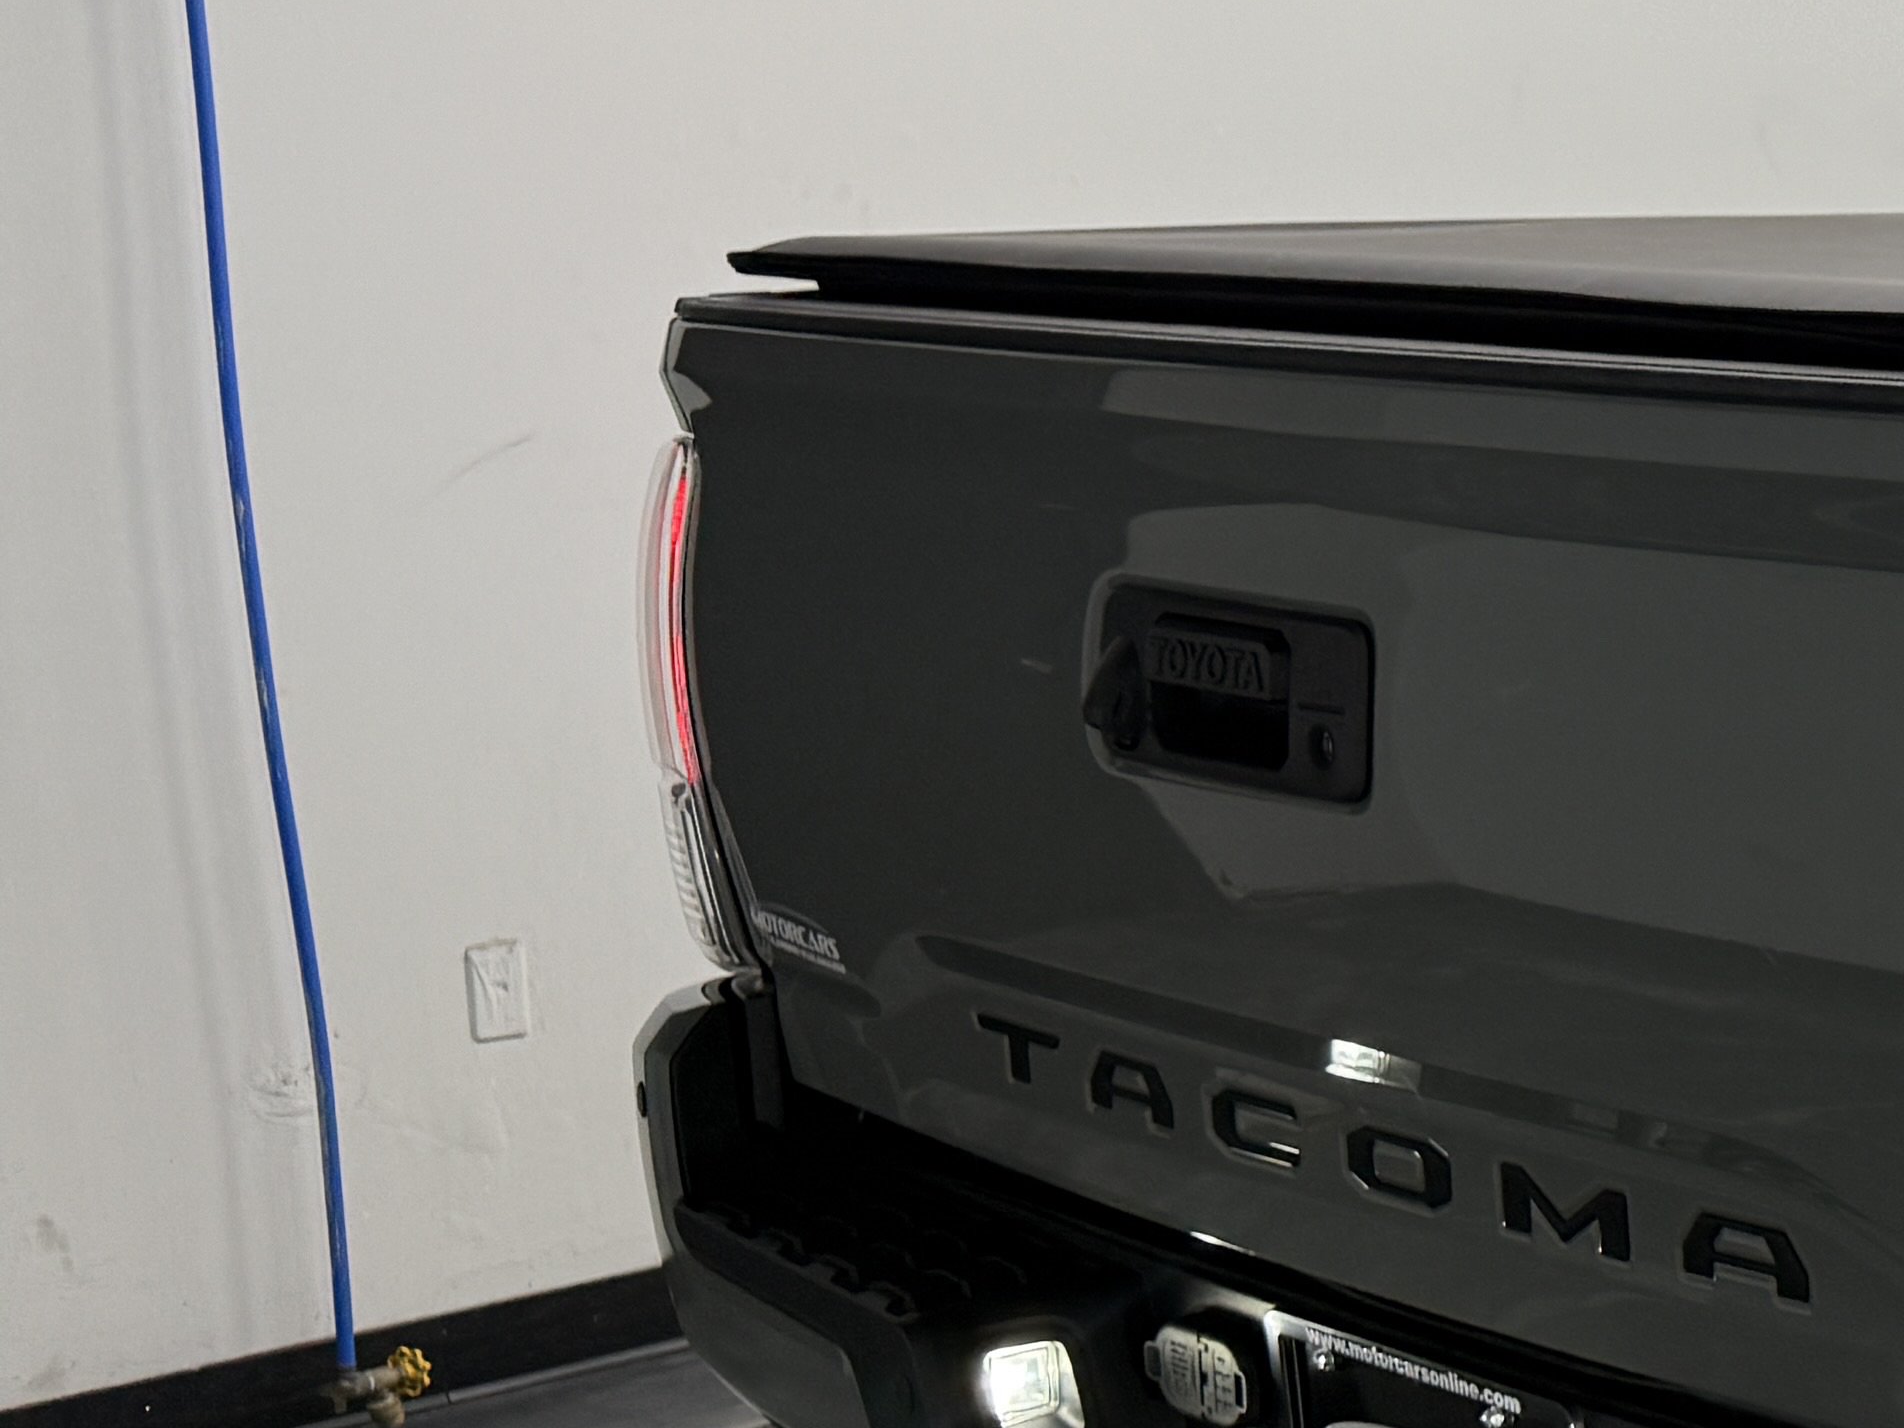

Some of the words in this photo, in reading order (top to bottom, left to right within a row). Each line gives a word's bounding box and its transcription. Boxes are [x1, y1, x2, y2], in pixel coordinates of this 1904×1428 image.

[1153, 636, 1264, 692] TOYOTA
[750, 905, 840, 961] MOTORCARS
[974, 1012, 1813, 1306] TACOMA
[1306, 1327, 1522, 1415] www.motorcarsonline.com
